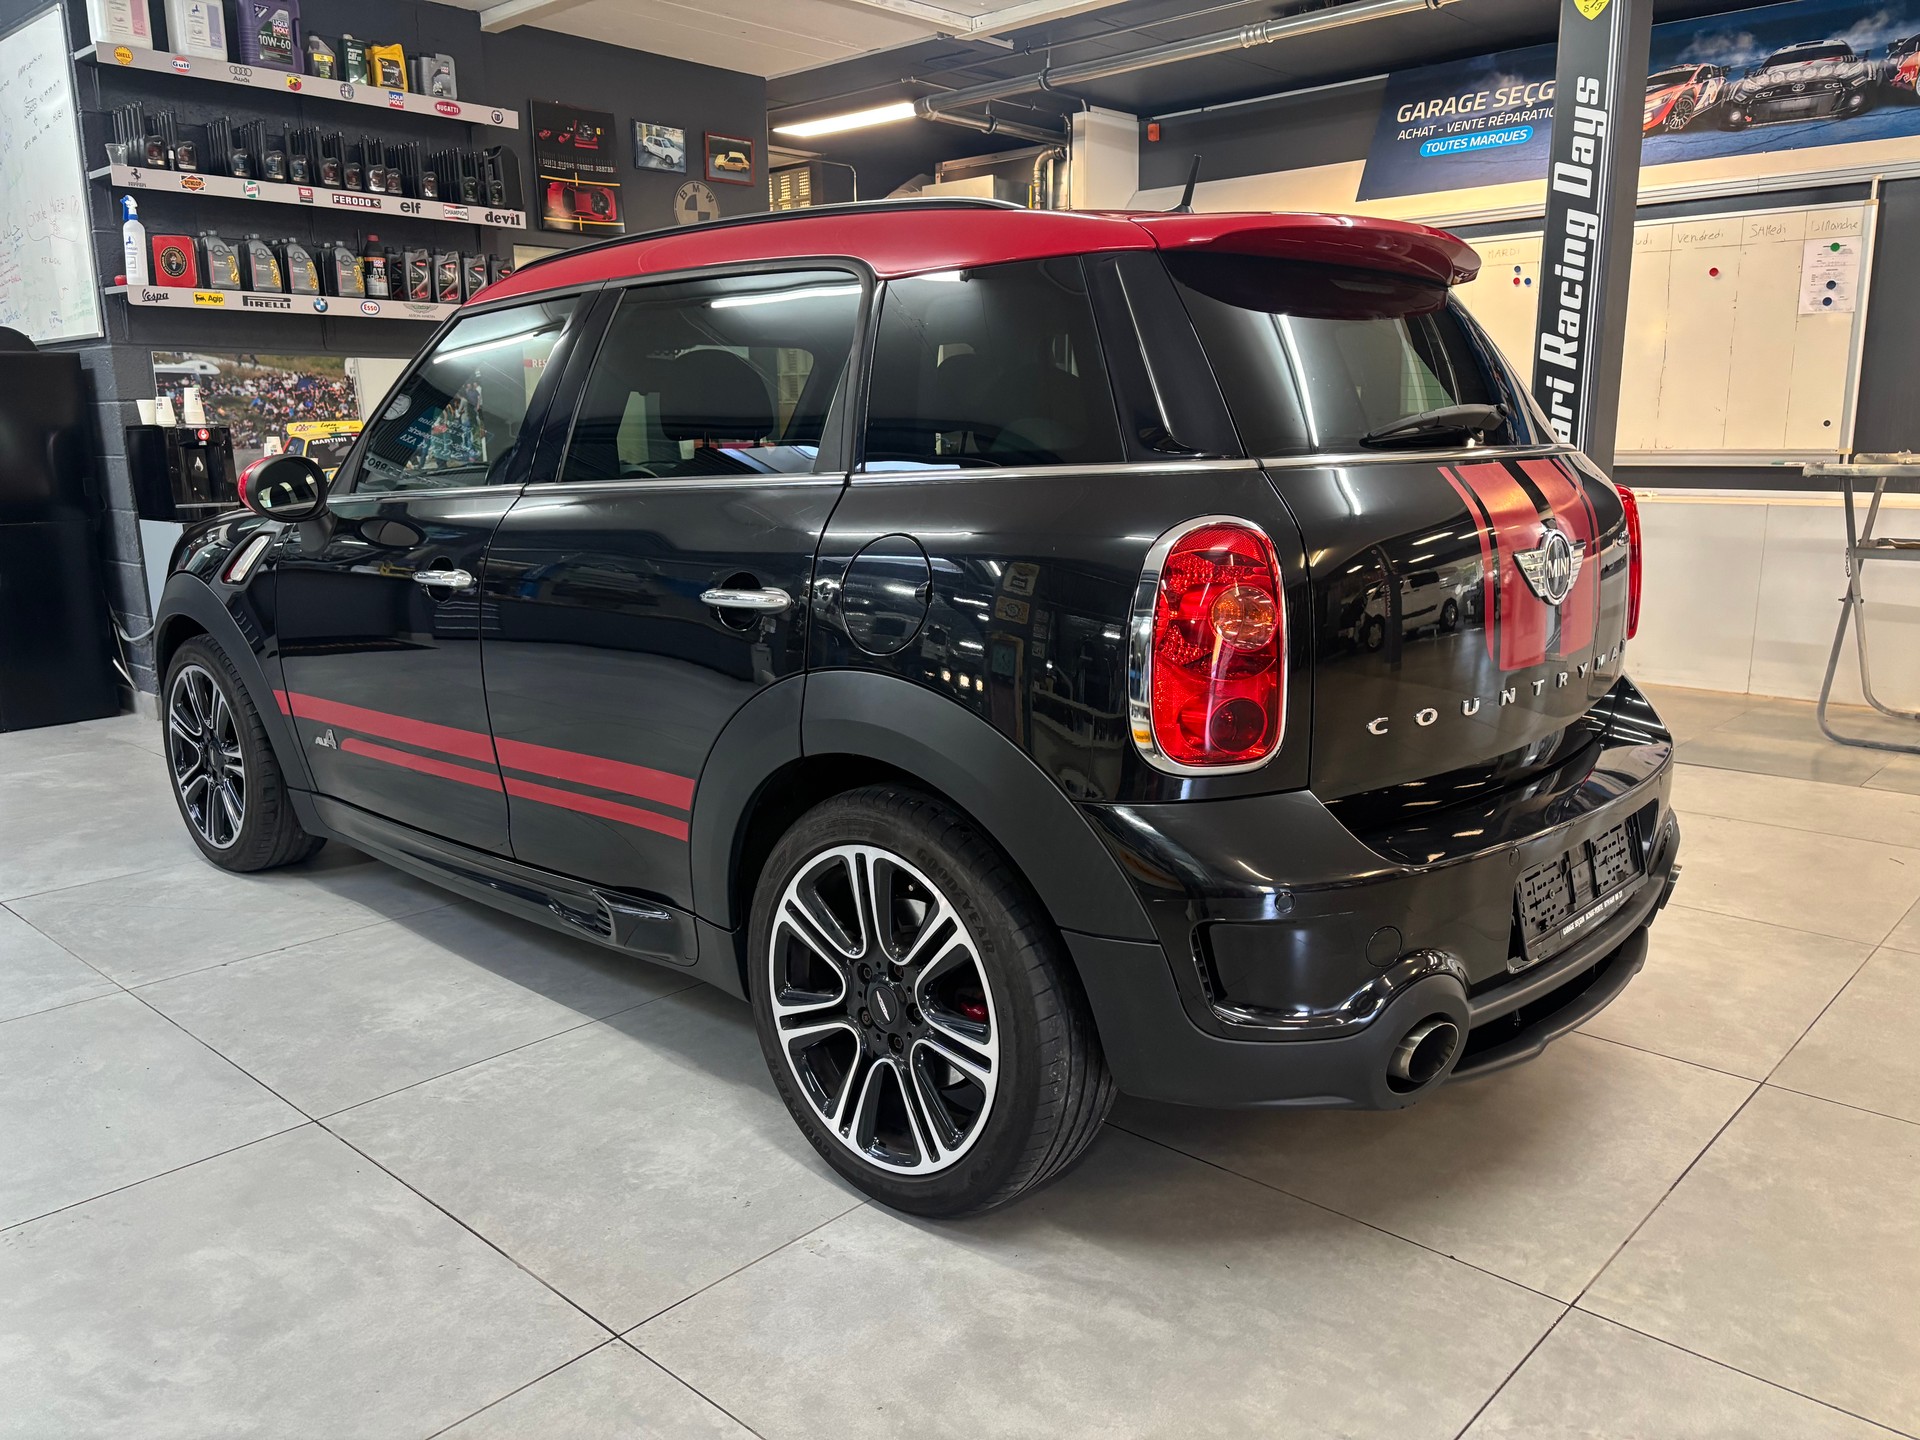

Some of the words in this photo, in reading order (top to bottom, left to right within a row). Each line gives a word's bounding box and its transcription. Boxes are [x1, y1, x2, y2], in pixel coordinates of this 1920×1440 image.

[258, 35, 291, 50] 10W-60
[172, 60, 190, 69] Gulf
[233, 75, 250, 84] Audi
[436, 102, 459, 114] BUGATTI
[1396, 90, 1489, 123] GARAGE
[1493, 80, 1556, 108] SEÇG
[1397, 125, 1437, 141] ACHAT
[1446, 117, 1487, 133] VENTE
[1426, 138, 1468, 153] TOUTES
[1469, 129, 1527, 147] MARQUES
[1552, 76, 1608, 198] Days
[333, 194, 371, 207] FERODO
[679, 183, 715, 204] BMW
[400, 203, 421, 214] elf
[444, 208, 468, 218] CHAMPION
[485, 211, 520, 226] devil
[142, 288, 169, 303] Vespa
[1539, 208, 1599, 370] Racing
[208, 295, 223, 304] Agip
[242, 295, 291, 309] PIRELLI
[311, 437, 347, 446] MARTINI
[1547, 558, 1569, 578] MINI
[917, 848, 995, 953] GOODYEAR
